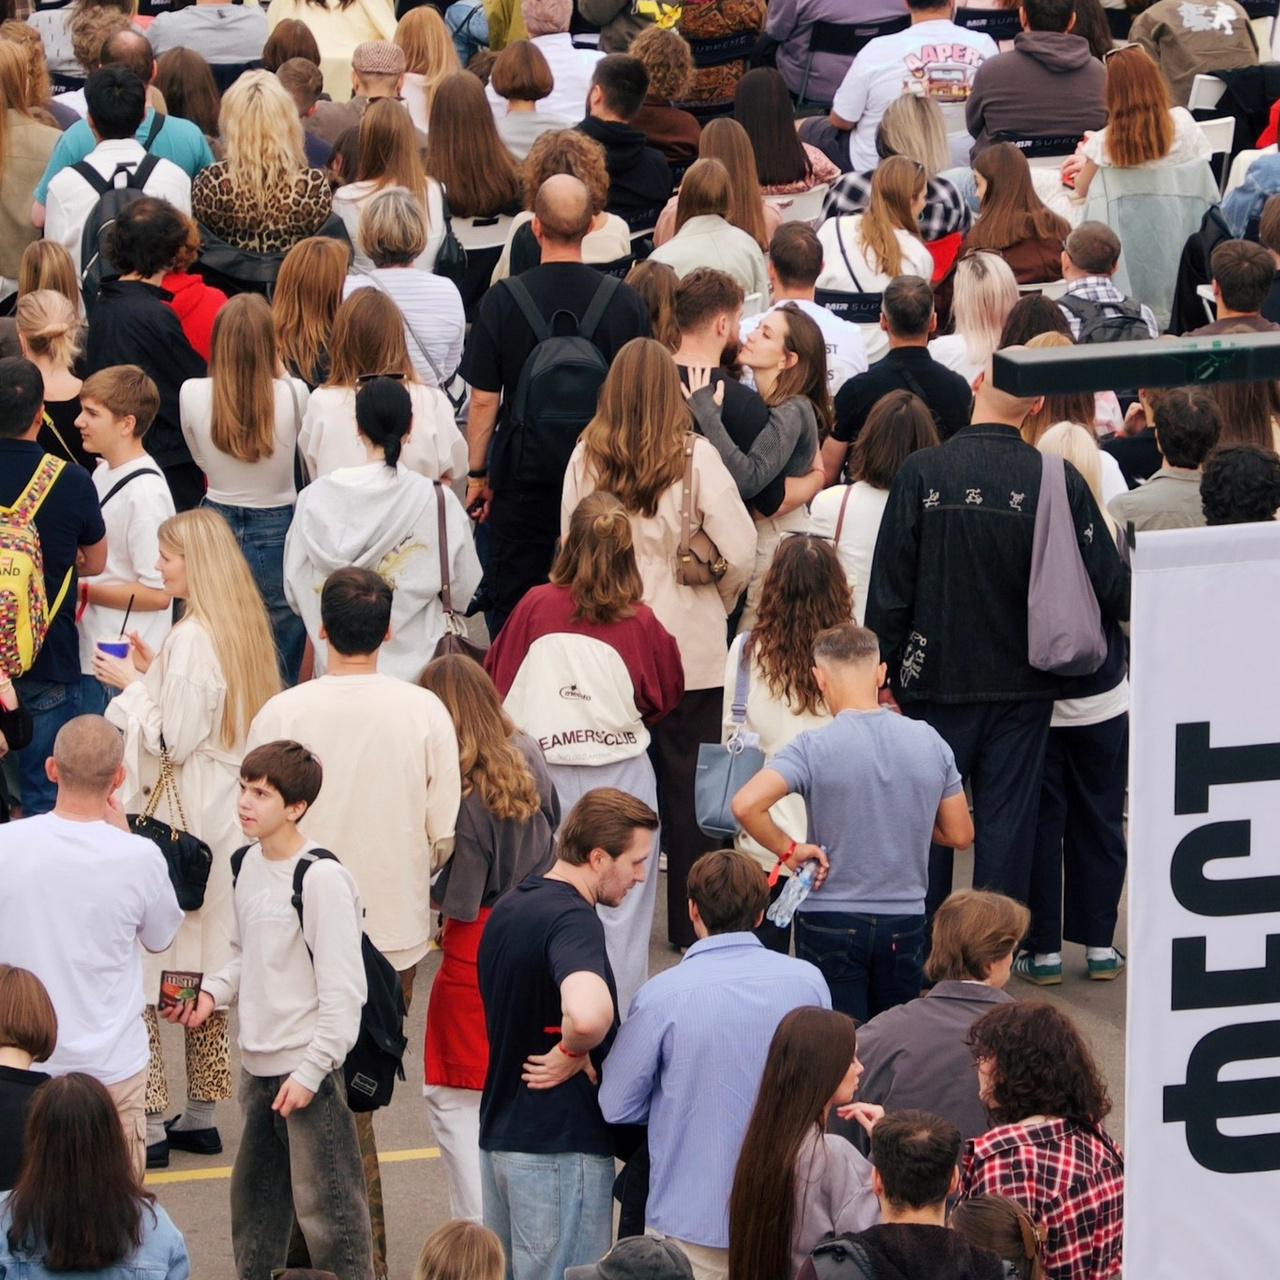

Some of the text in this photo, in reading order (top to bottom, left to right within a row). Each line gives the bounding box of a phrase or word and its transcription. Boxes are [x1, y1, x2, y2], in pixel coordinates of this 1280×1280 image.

[966, 19, 988, 27] MIR
[696, 36, 748, 51] UPREME
[825, 302, 849, 311] MIR
